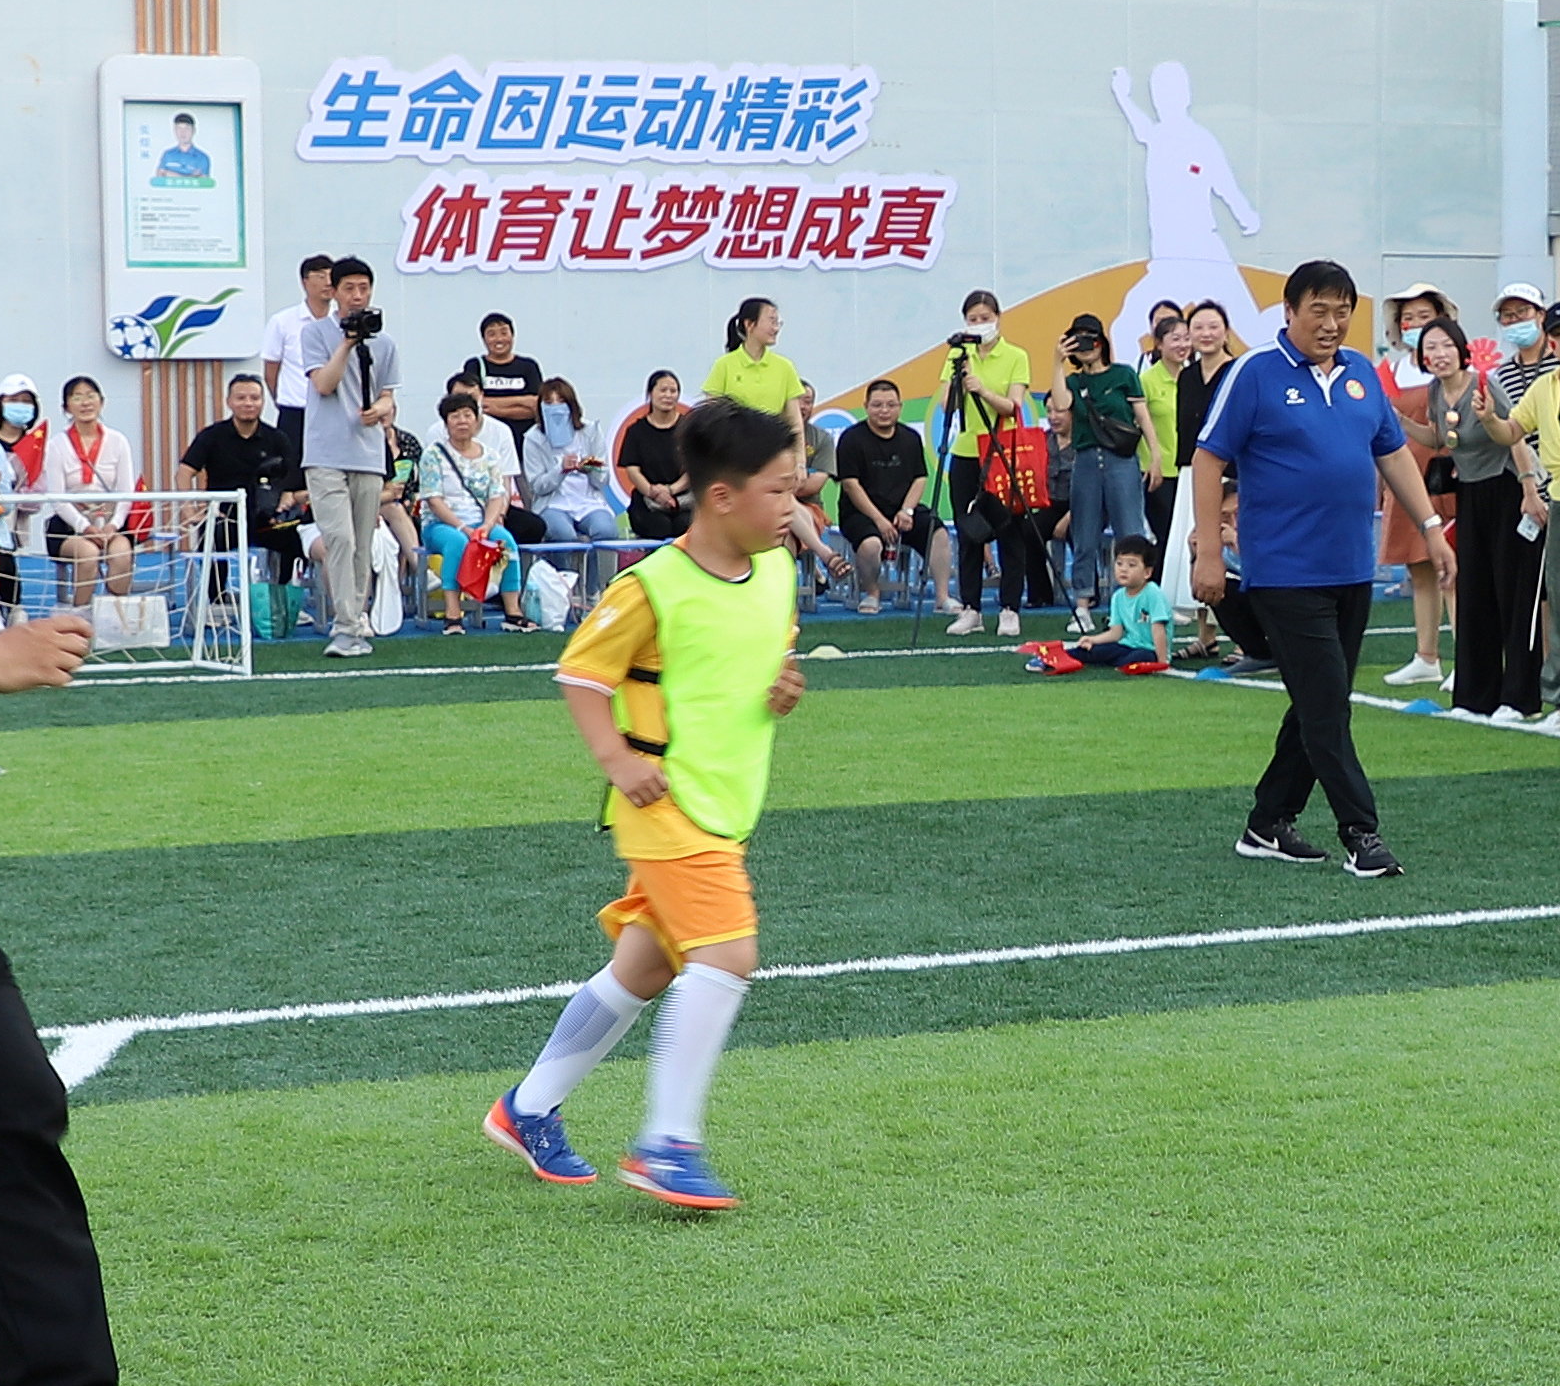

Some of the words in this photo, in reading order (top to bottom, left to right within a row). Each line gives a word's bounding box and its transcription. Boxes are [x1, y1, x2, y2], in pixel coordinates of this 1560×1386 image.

[310, 69, 869, 152] 生命因运动精彩
[408, 184, 945, 261] 体育让梦想成真
